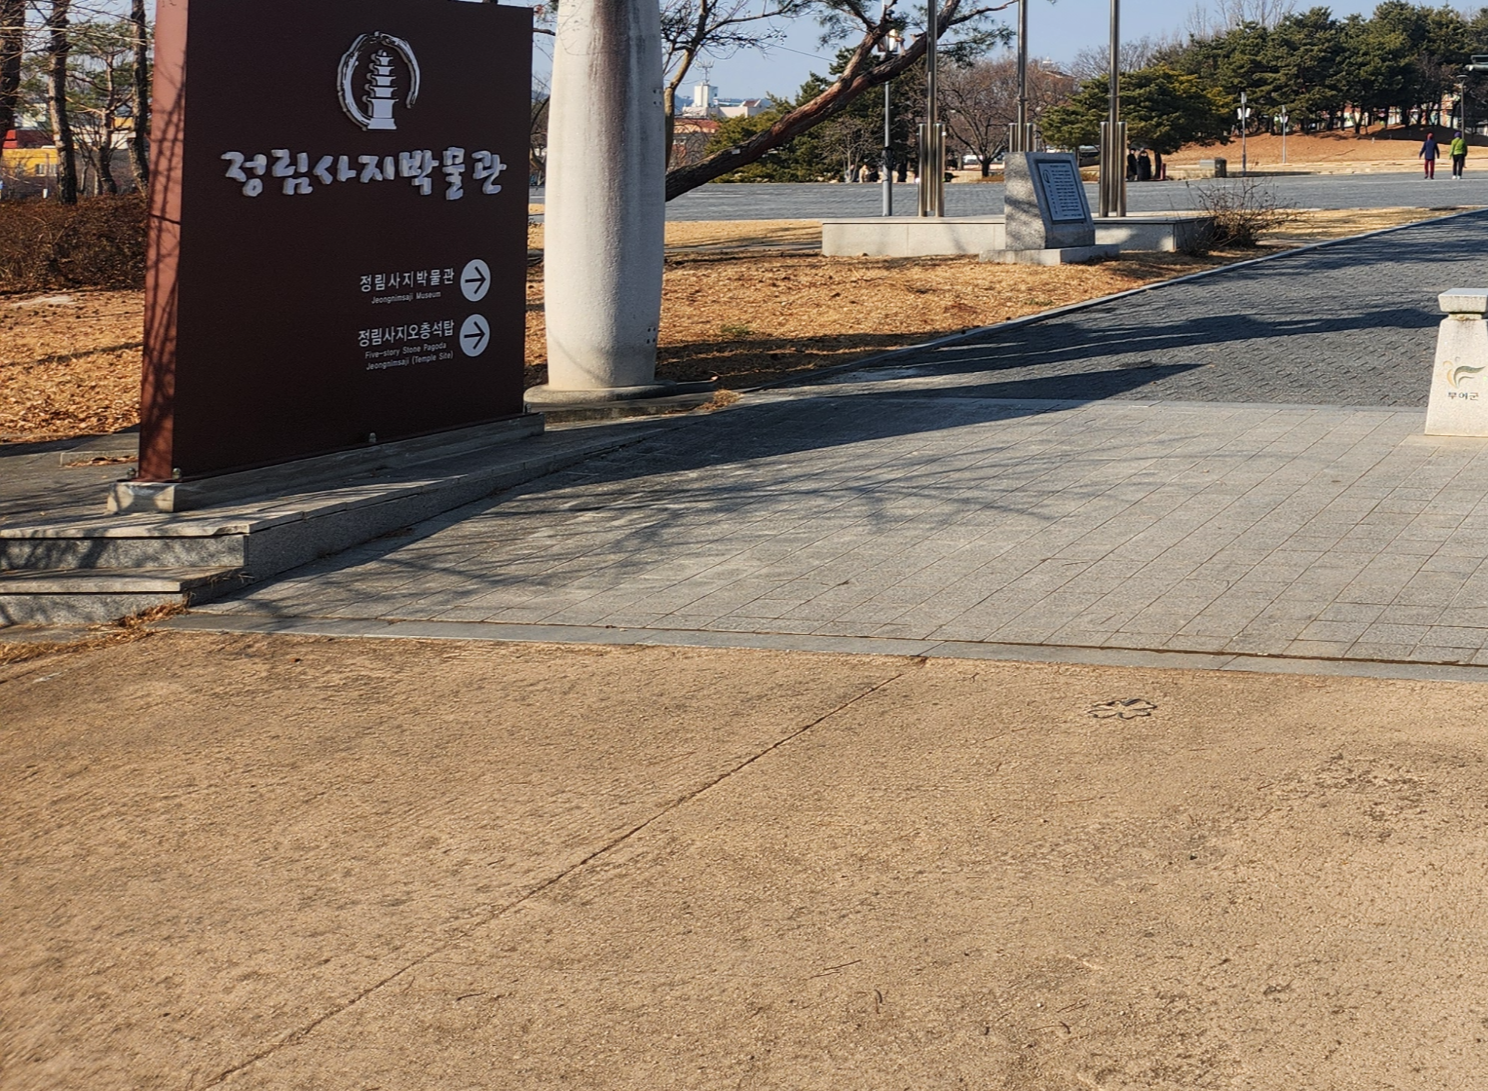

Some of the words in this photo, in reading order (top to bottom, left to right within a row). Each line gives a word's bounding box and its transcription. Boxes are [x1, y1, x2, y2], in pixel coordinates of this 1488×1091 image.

[220, 147, 507, 200] 정림사지박물관
[360, 268, 455, 292] 정림사지박물관
[371, 293, 414, 304] Jeongnimsaji
[416, 291, 441, 299] Museum
[358, 319, 455, 347] 정림사지오층석탑
[365, 348, 400, 359] Five-story
[403, 346, 421, 354] Stone
[423, 342, 447, 352] Pagoda
[366, 358, 409, 370] Jeongnimsaji
[412, 354, 437, 364] (Temple
[439, 350, 454, 360] Site)
